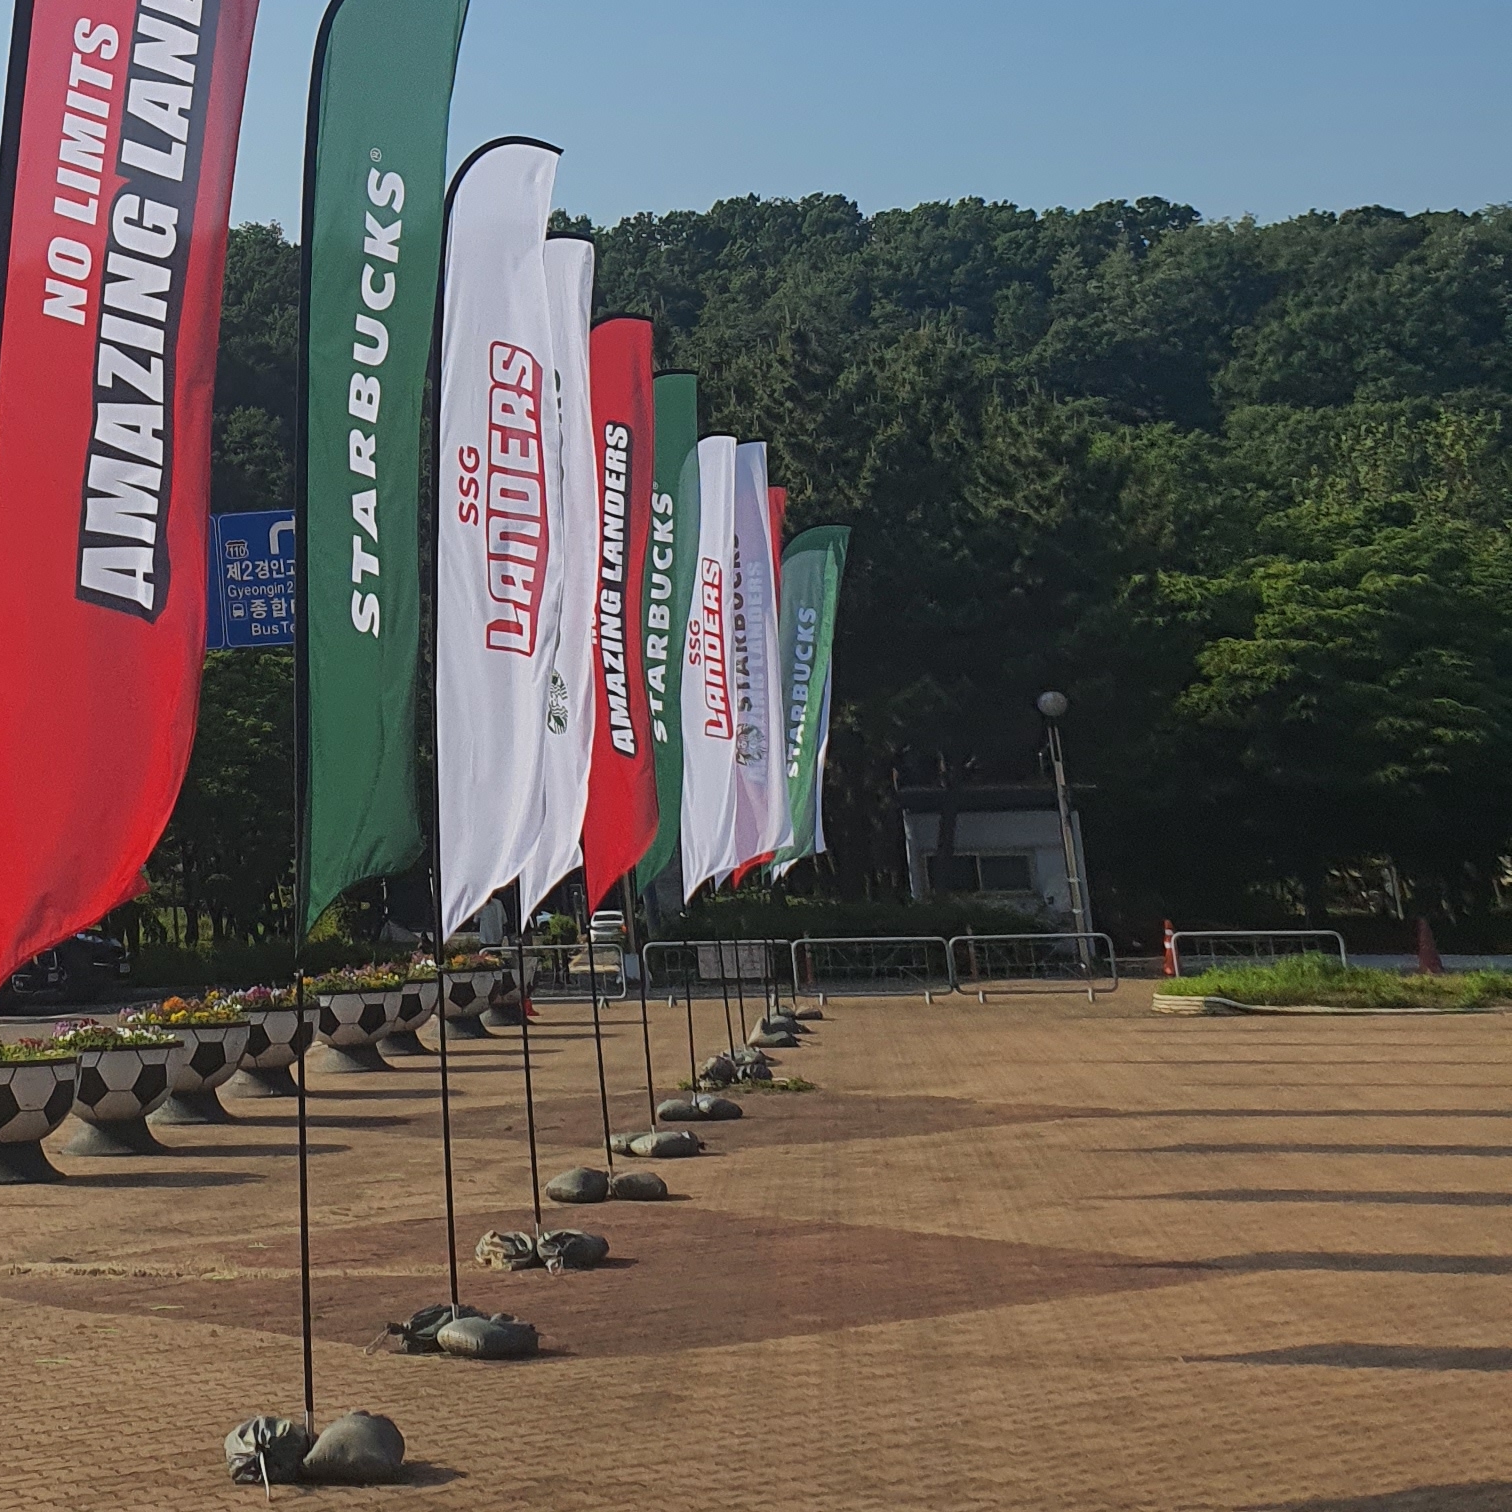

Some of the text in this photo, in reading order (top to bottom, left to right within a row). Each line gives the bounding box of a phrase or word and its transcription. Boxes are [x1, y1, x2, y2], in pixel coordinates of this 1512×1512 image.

[42, 17, 120, 326] NO LIMITS
[80, 193, 180, 611] AMAZING
[458, 445, 481, 527] SSG
[229, 546, 246, 558] 110
[486, 341, 547, 656] LANDERS
[228, 582, 285, 599] Gyeongin
[251, 622, 279, 636] Bus
[600, 424, 636, 755] AMAZING LANDERS
[689, 619, 701, 666] SSG
[702, 557, 733, 739] LANDERS
[788, 606, 817, 778] STARBUCKS
